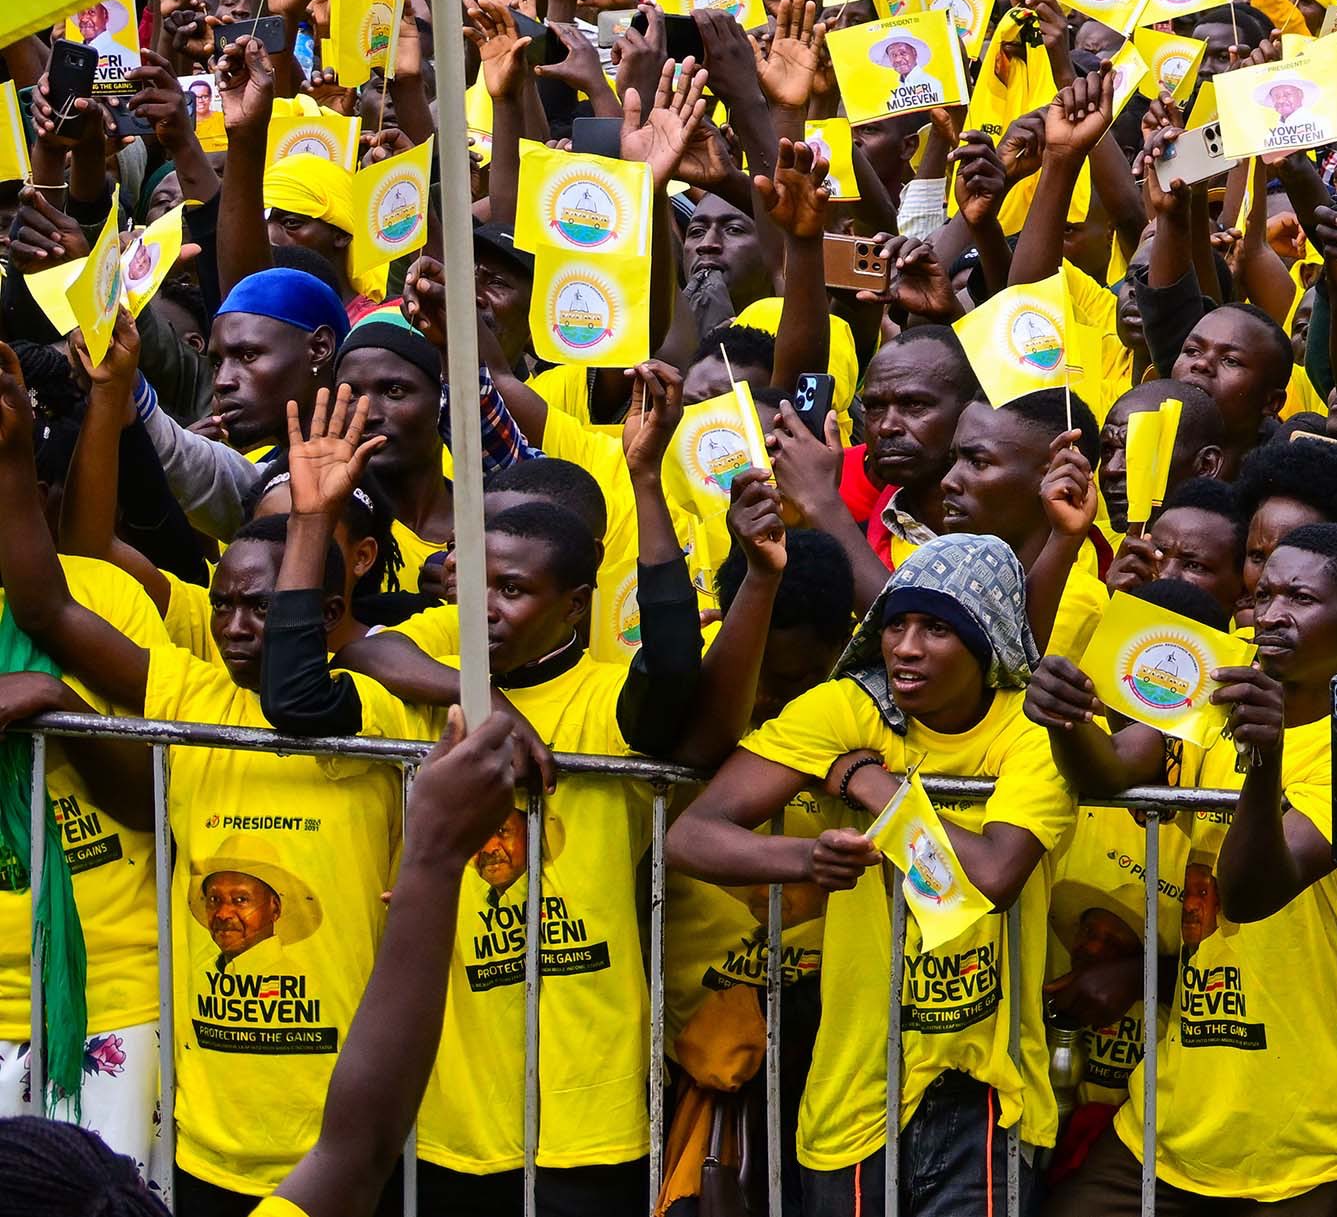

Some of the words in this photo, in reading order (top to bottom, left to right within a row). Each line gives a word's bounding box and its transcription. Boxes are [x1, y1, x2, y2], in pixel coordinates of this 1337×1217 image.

[886, 93, 939, 112] MUSEVENI
[1263, 130, 1324, 147] MUSEVENI
[223, 816, 303, 831] PRESIDENT
[77, 843, 108, 861] GAINS
[556, 950, 591, 963] GAINS
[205, 971, 306, 999] YOWERI
[198, 994, 321, 1024] MUSEVENI
[962, 1004, 983, 1017] THE
[199, 1025, 257, 1042] PROTECTING
[260, 1031, 282, 1042] THE
[285, 1031, 322, 1042] GAINS
[1205, 1024, 1227, 1035] THE
